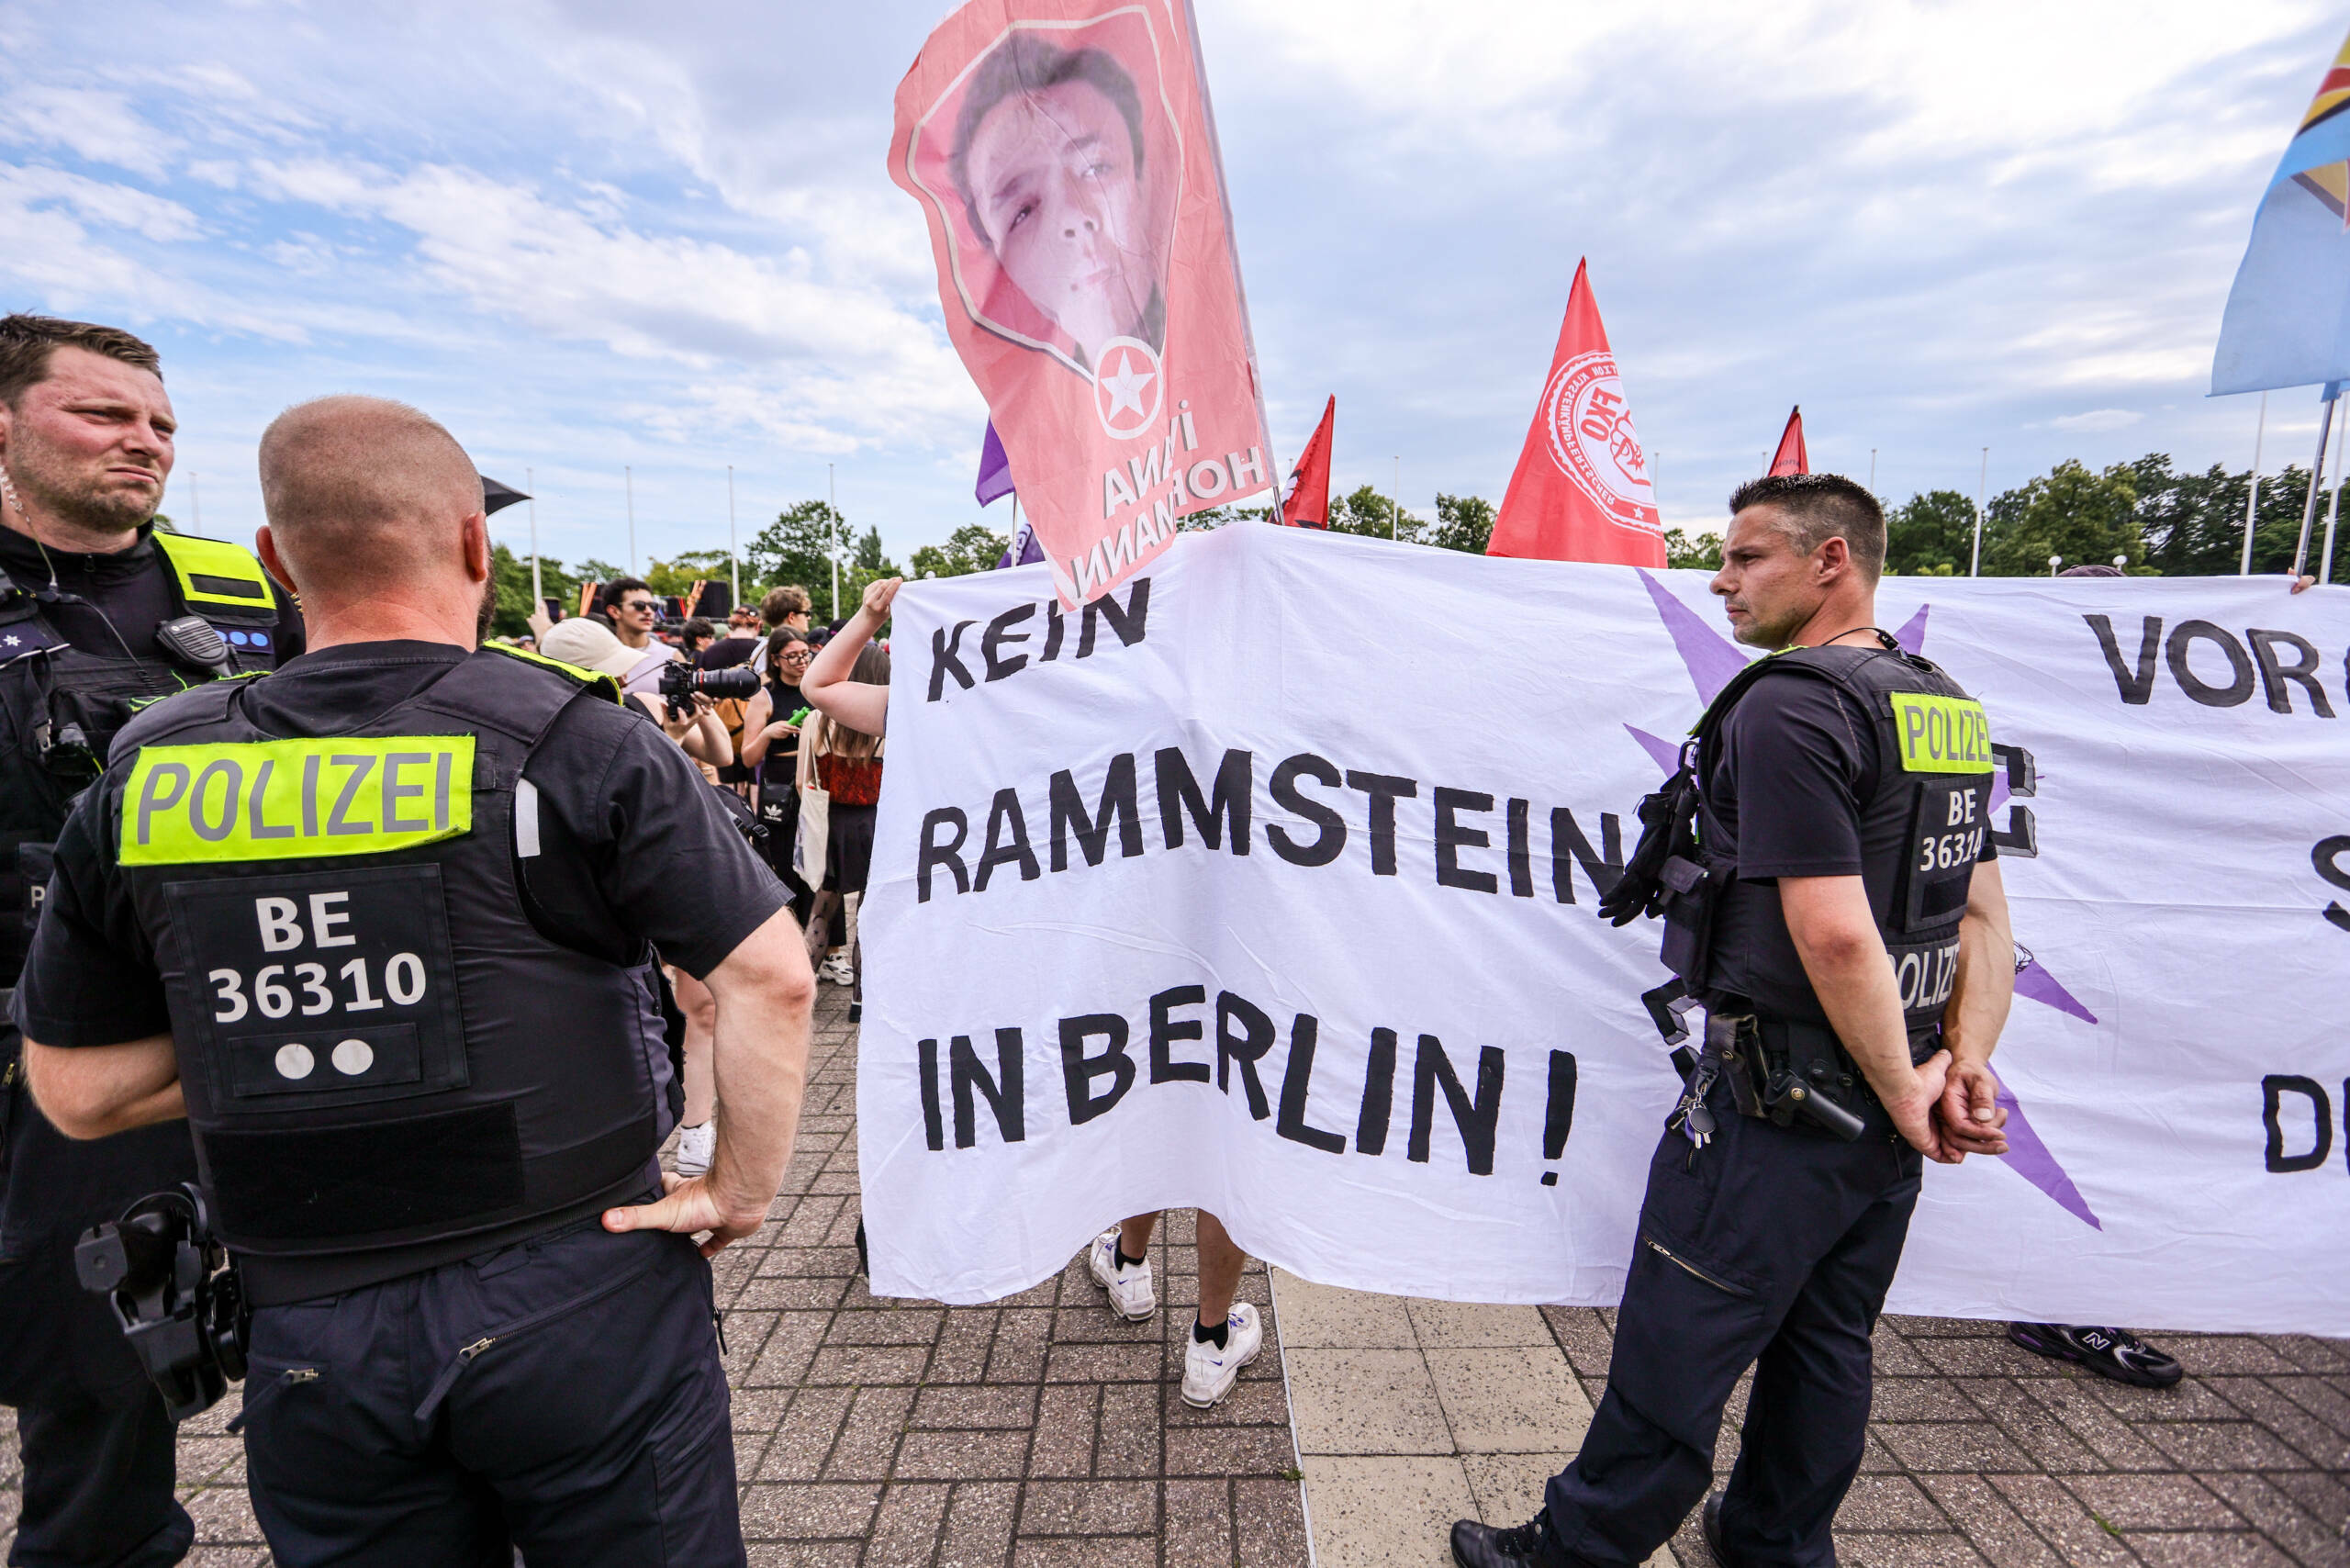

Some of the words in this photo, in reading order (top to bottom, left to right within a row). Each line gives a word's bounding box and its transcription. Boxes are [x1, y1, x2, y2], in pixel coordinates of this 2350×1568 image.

[927, 577, 1151, 702] KEIN
[2082, 614, 2350, 718] VOR
[137, 752, 453, 846] POLIZEI
[918, 746, 1625, 905] RAMMSTEIN
[1947, 789, 1976, 826] BE
[255, 890, 356, 953] BE
[208, 952, 427, 1023] 36310
[918, 1027, 1025, 1151] IN
